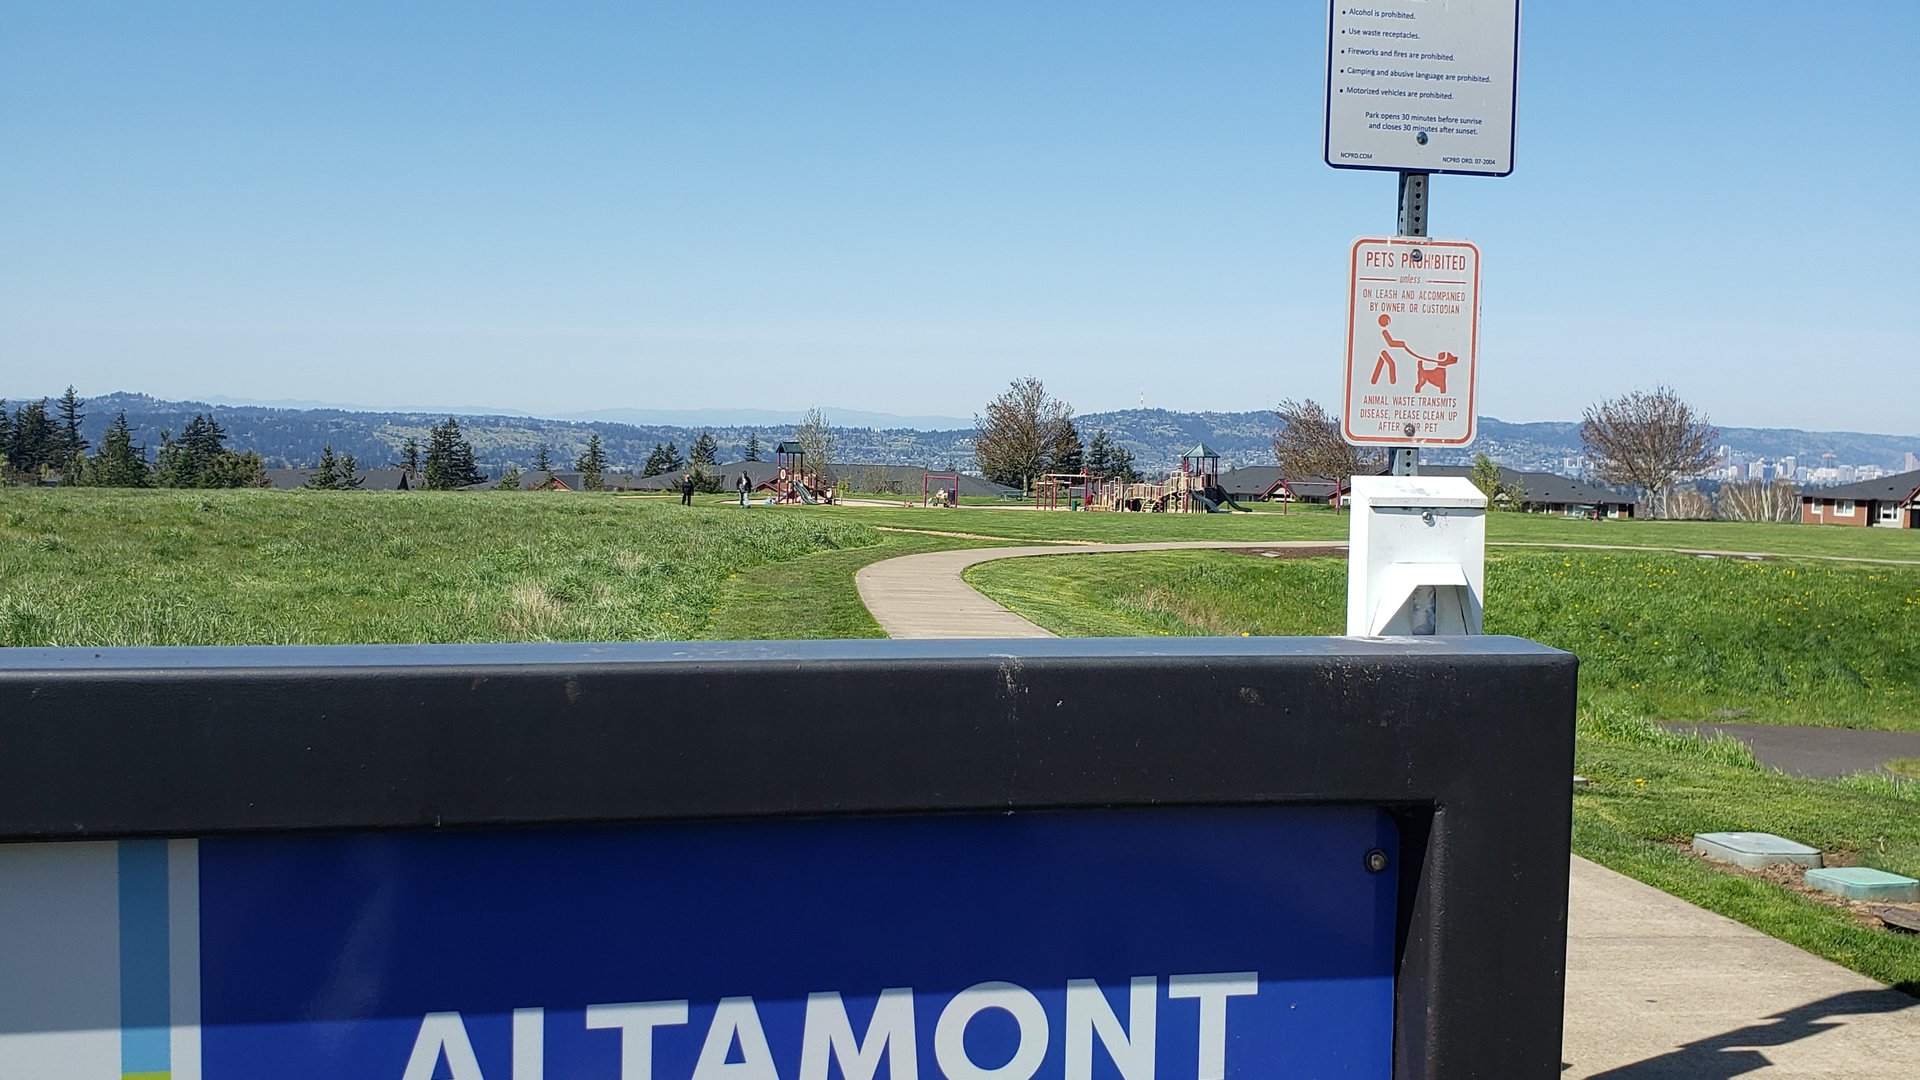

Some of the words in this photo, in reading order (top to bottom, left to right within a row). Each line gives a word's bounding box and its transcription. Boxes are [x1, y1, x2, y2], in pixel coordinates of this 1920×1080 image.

[1381, 11, 1416, 19] prohibited.
[1382, 31, 1420, 39] receptacles.
[1348, 48, 1378, 56] Fireworks
[1420, 53, 1455, 61] prohibited.
[1347, 68, 1375, 76] Camping
[1390, 70, 1414, 78] abusive
[1416, 71, 1444, 80] language
[1457, 74, 1491, 83] prohibited.
[1347, 87, 1379, 95] Motorized
[1381, 88, 1406, 96] vehicles
[1419, 91, 1453, 99] prohibited.
[1381, 113, 1400, 121] opens
[1382, 123, 1401, 131] closes
[1366, 252, 1394, 268] PETS
[1400, 275, 1421, 284] unless
[1363, 289, 1372, 298] ON
[1376, 289, 1397, 299] LEASH
[1402, 290, 1415, 299] AND
[1419, 291, 1465, 301] ACCOMPANIED
[1370, 302, 1378, 311] BY
[1382, 303, 1405, 312] OWNER
[1410, 304, 1418, 312] OR
[1423, 304, 1459, 314] CUSTODIAN
[1363, 395, 1388, 405] ANIMAL
[1393, 396, 1415, 406] WASTE
[1419, 397, 1456, 408] TRANSMITS
[1360, 409, 1391, 419] DISEASE,
[1395, 410, 1420, 420] PLEASE
[1423, 411, 1444, 420] CLEAN
[1449, 412, 1457, 421] UP
[1378, 422, 1400, 431] AFTER
[1425, 423, 1438, 432] PET
